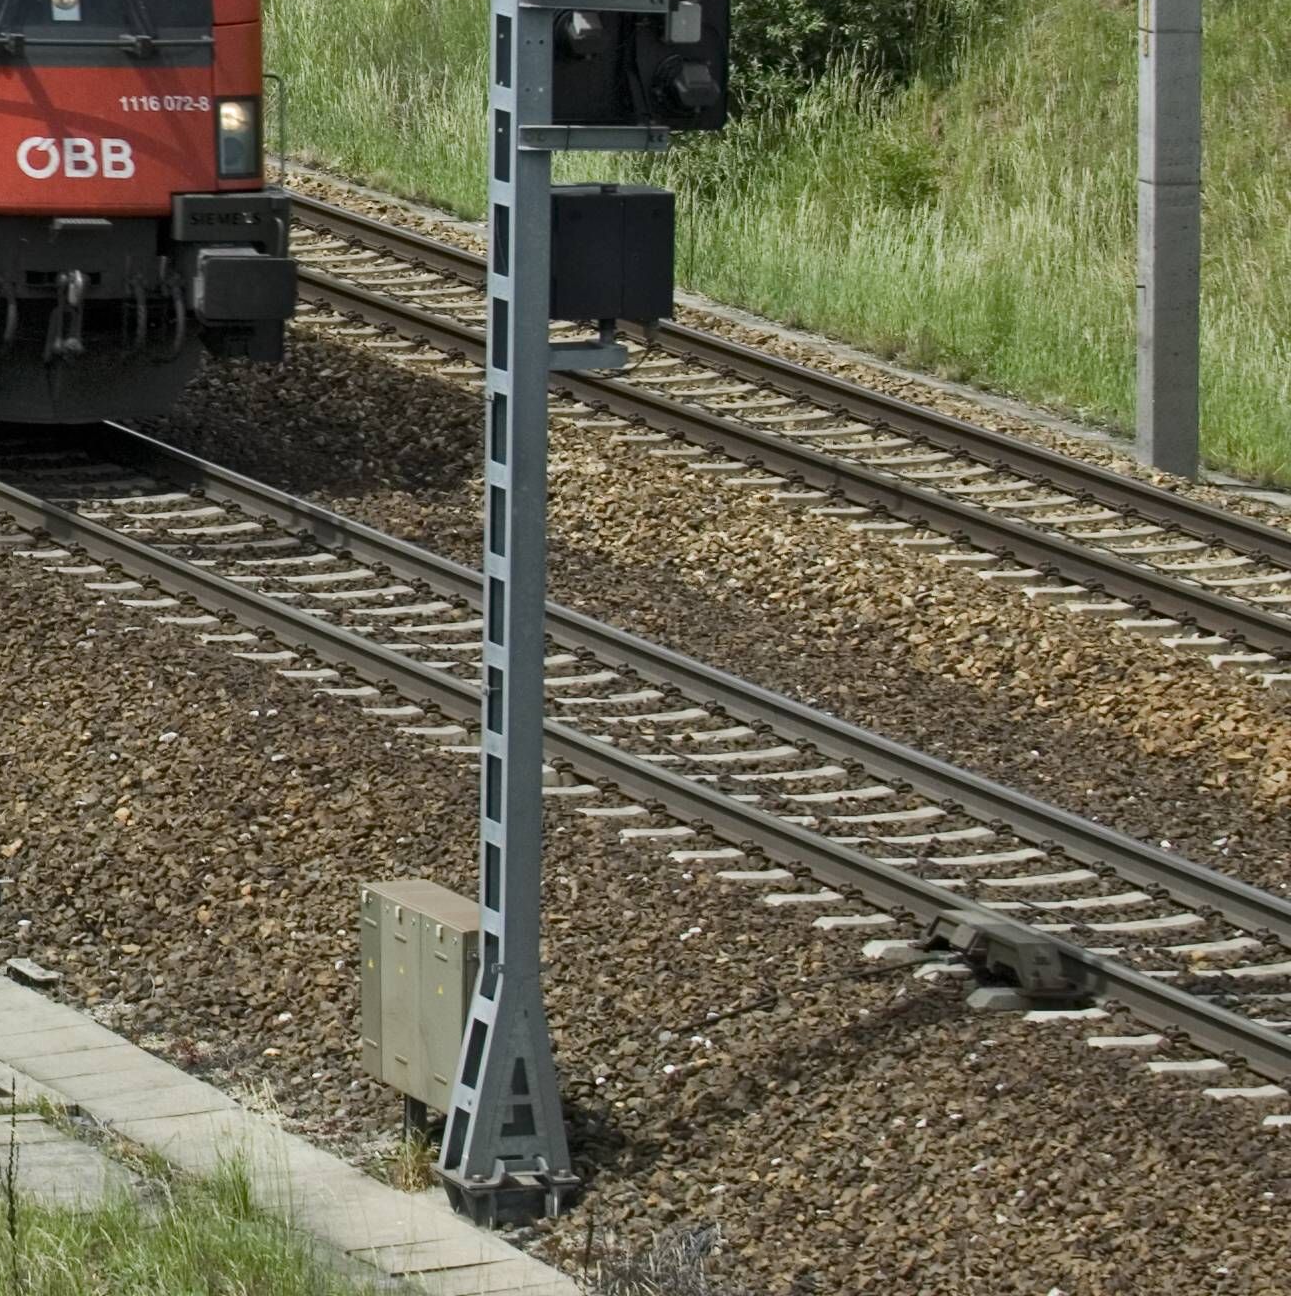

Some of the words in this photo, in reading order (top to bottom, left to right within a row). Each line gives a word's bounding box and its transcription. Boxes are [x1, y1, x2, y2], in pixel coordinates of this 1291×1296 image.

[118, 95, 161, 113] 1116
[164, 95, 211, 113] 072-8
[16, 136, 136, 180] ÖBB
